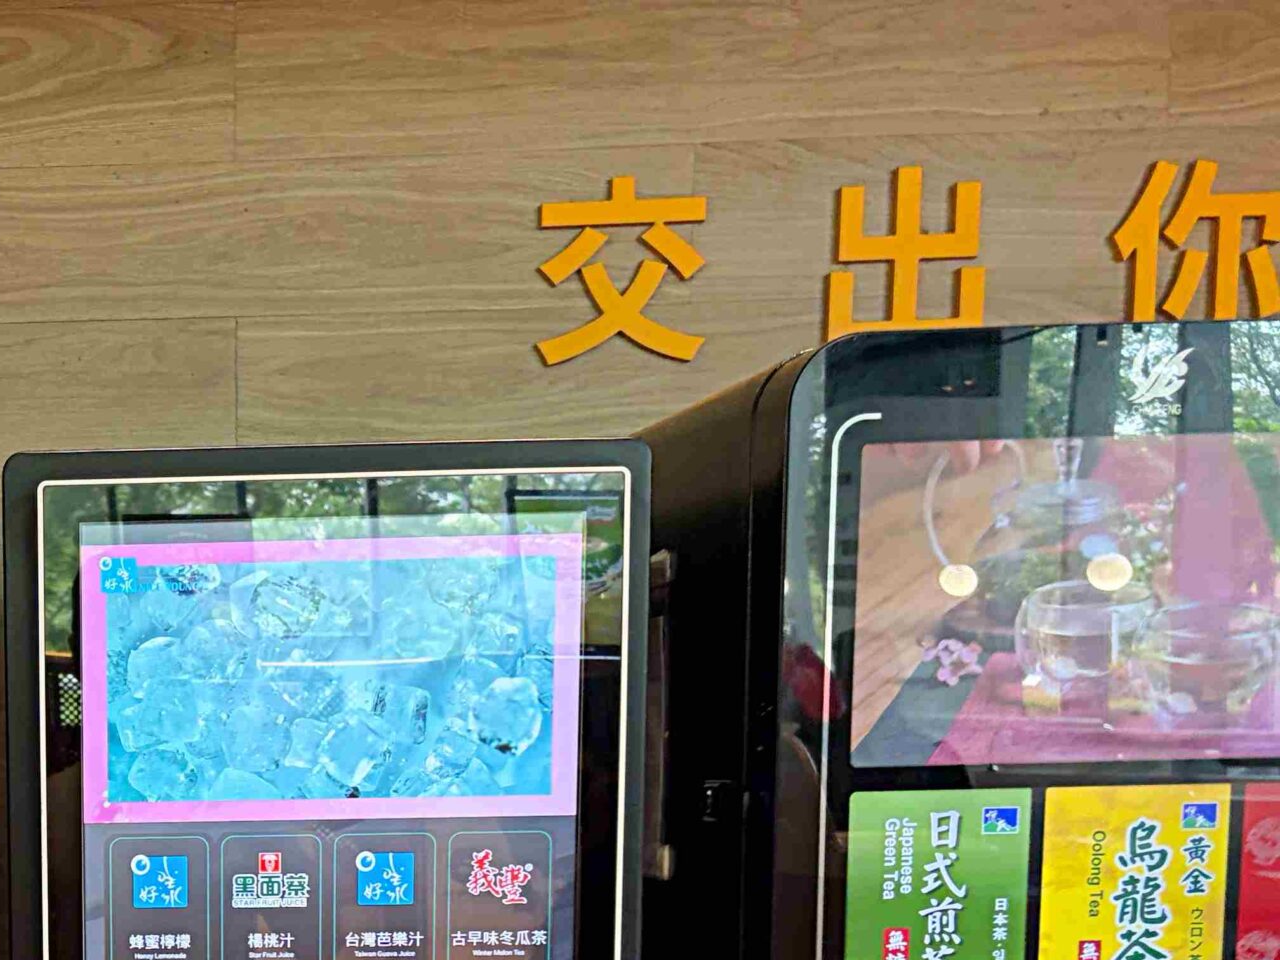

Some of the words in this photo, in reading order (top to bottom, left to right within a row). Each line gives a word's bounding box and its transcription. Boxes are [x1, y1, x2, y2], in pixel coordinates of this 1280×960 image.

[884, 817, 901, 867] Green
[899, 817, 917, 895] Japanese
[1086, 829, 1107, 887] Oolong
[1181, 836, 1213, 894] 黃金
[233, 874, 311, 898] 黑面蔡
[466, 849, 530, 905] 義豐
[882, 869, 899, 900] Tea
[1087, 891, 1105, 918] Tea
[129, 933, 191, 949] 蜂蜜檸檬
[247, 933, 295, 949] 楊桃汁
[345, 932, 424, 947] 台灣芭樂汁
[451, 931, 547, 946] 古早味冬瓜茶
[155, 952, 186, 960] Lemonade
